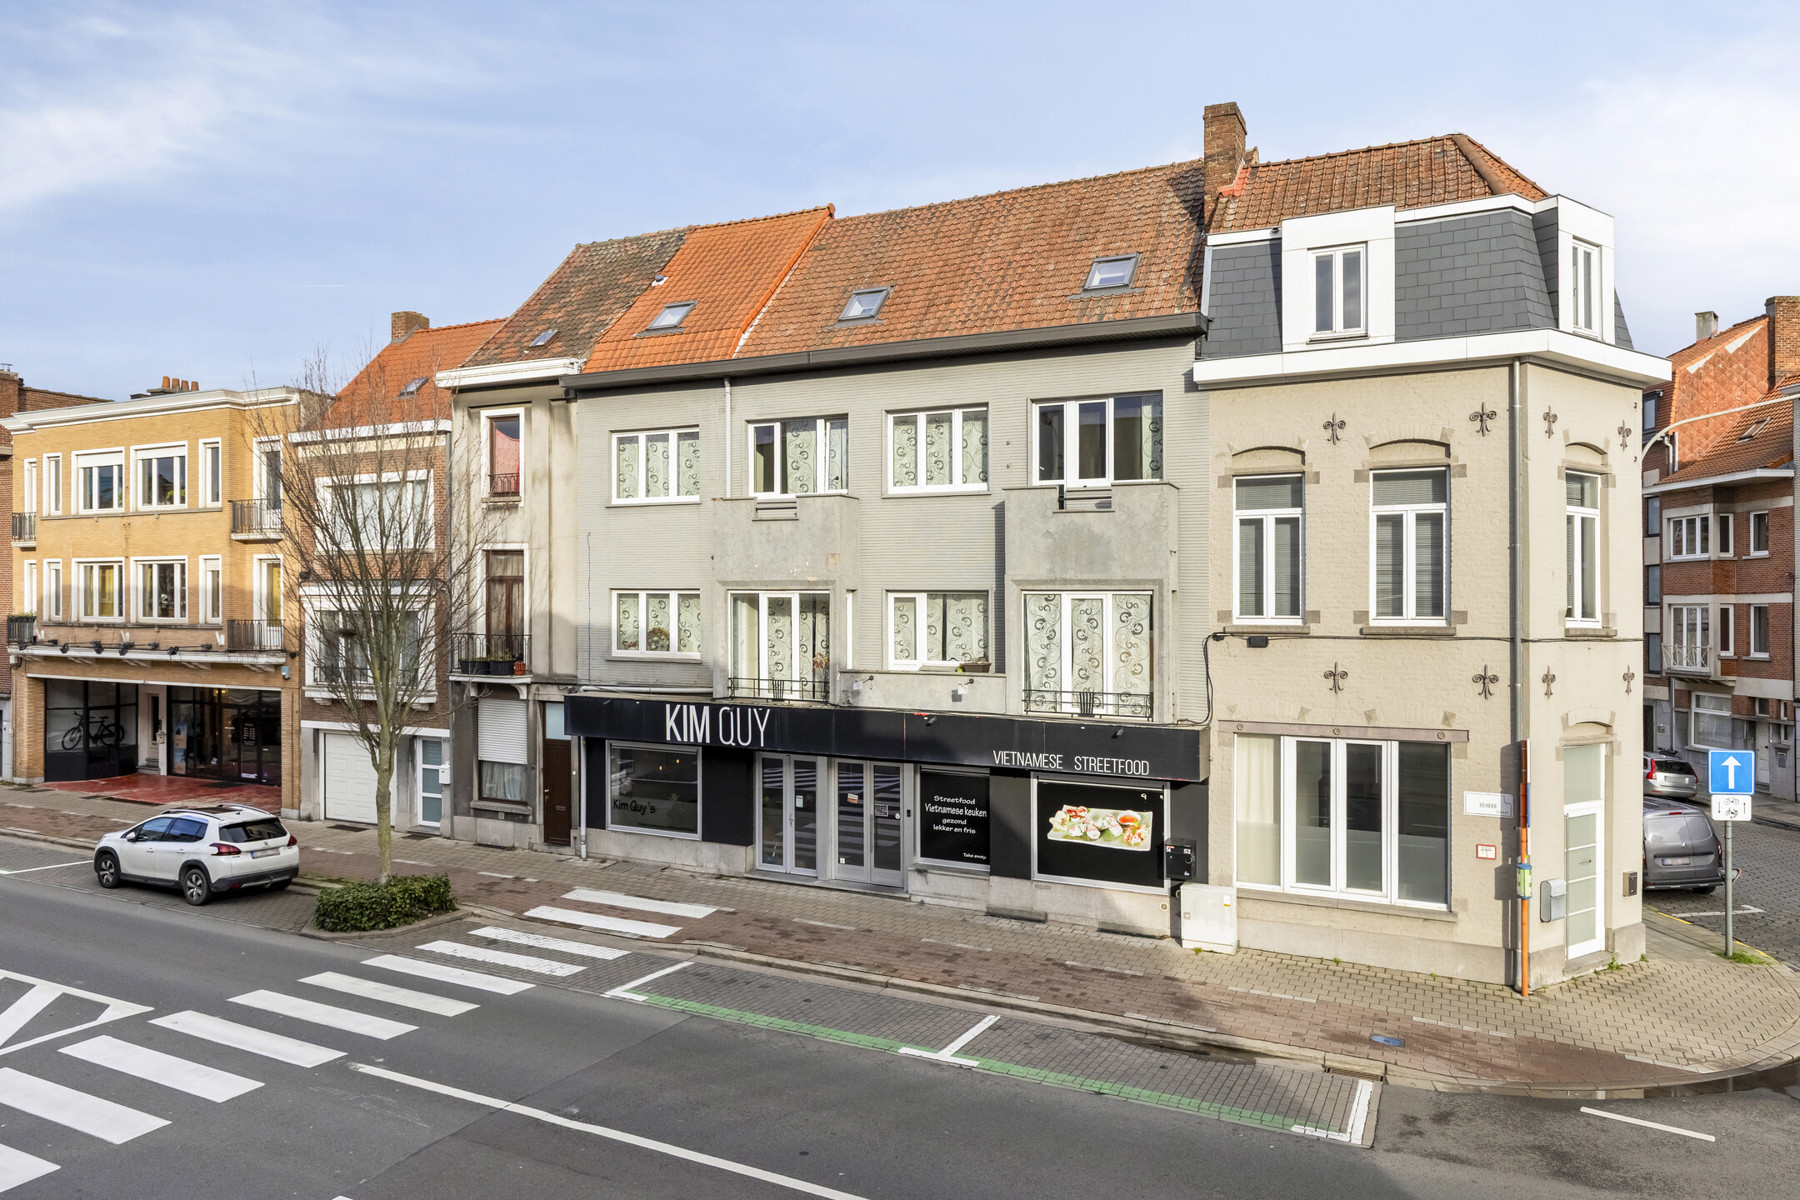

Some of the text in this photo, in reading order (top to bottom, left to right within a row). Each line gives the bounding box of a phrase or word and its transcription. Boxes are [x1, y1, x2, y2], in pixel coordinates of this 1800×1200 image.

[665, 703, 771, 747] KIM QUY
[993, 750, 1150, 776] VIETNAMESE STREETFOOD
[613, 798, 656, 815] Kim Quy's
[933, 795, 976, 805] Streetfood
[925, 803, 987, 818] Vietnamese keuken
[933, 824, 953, 832] lekker
